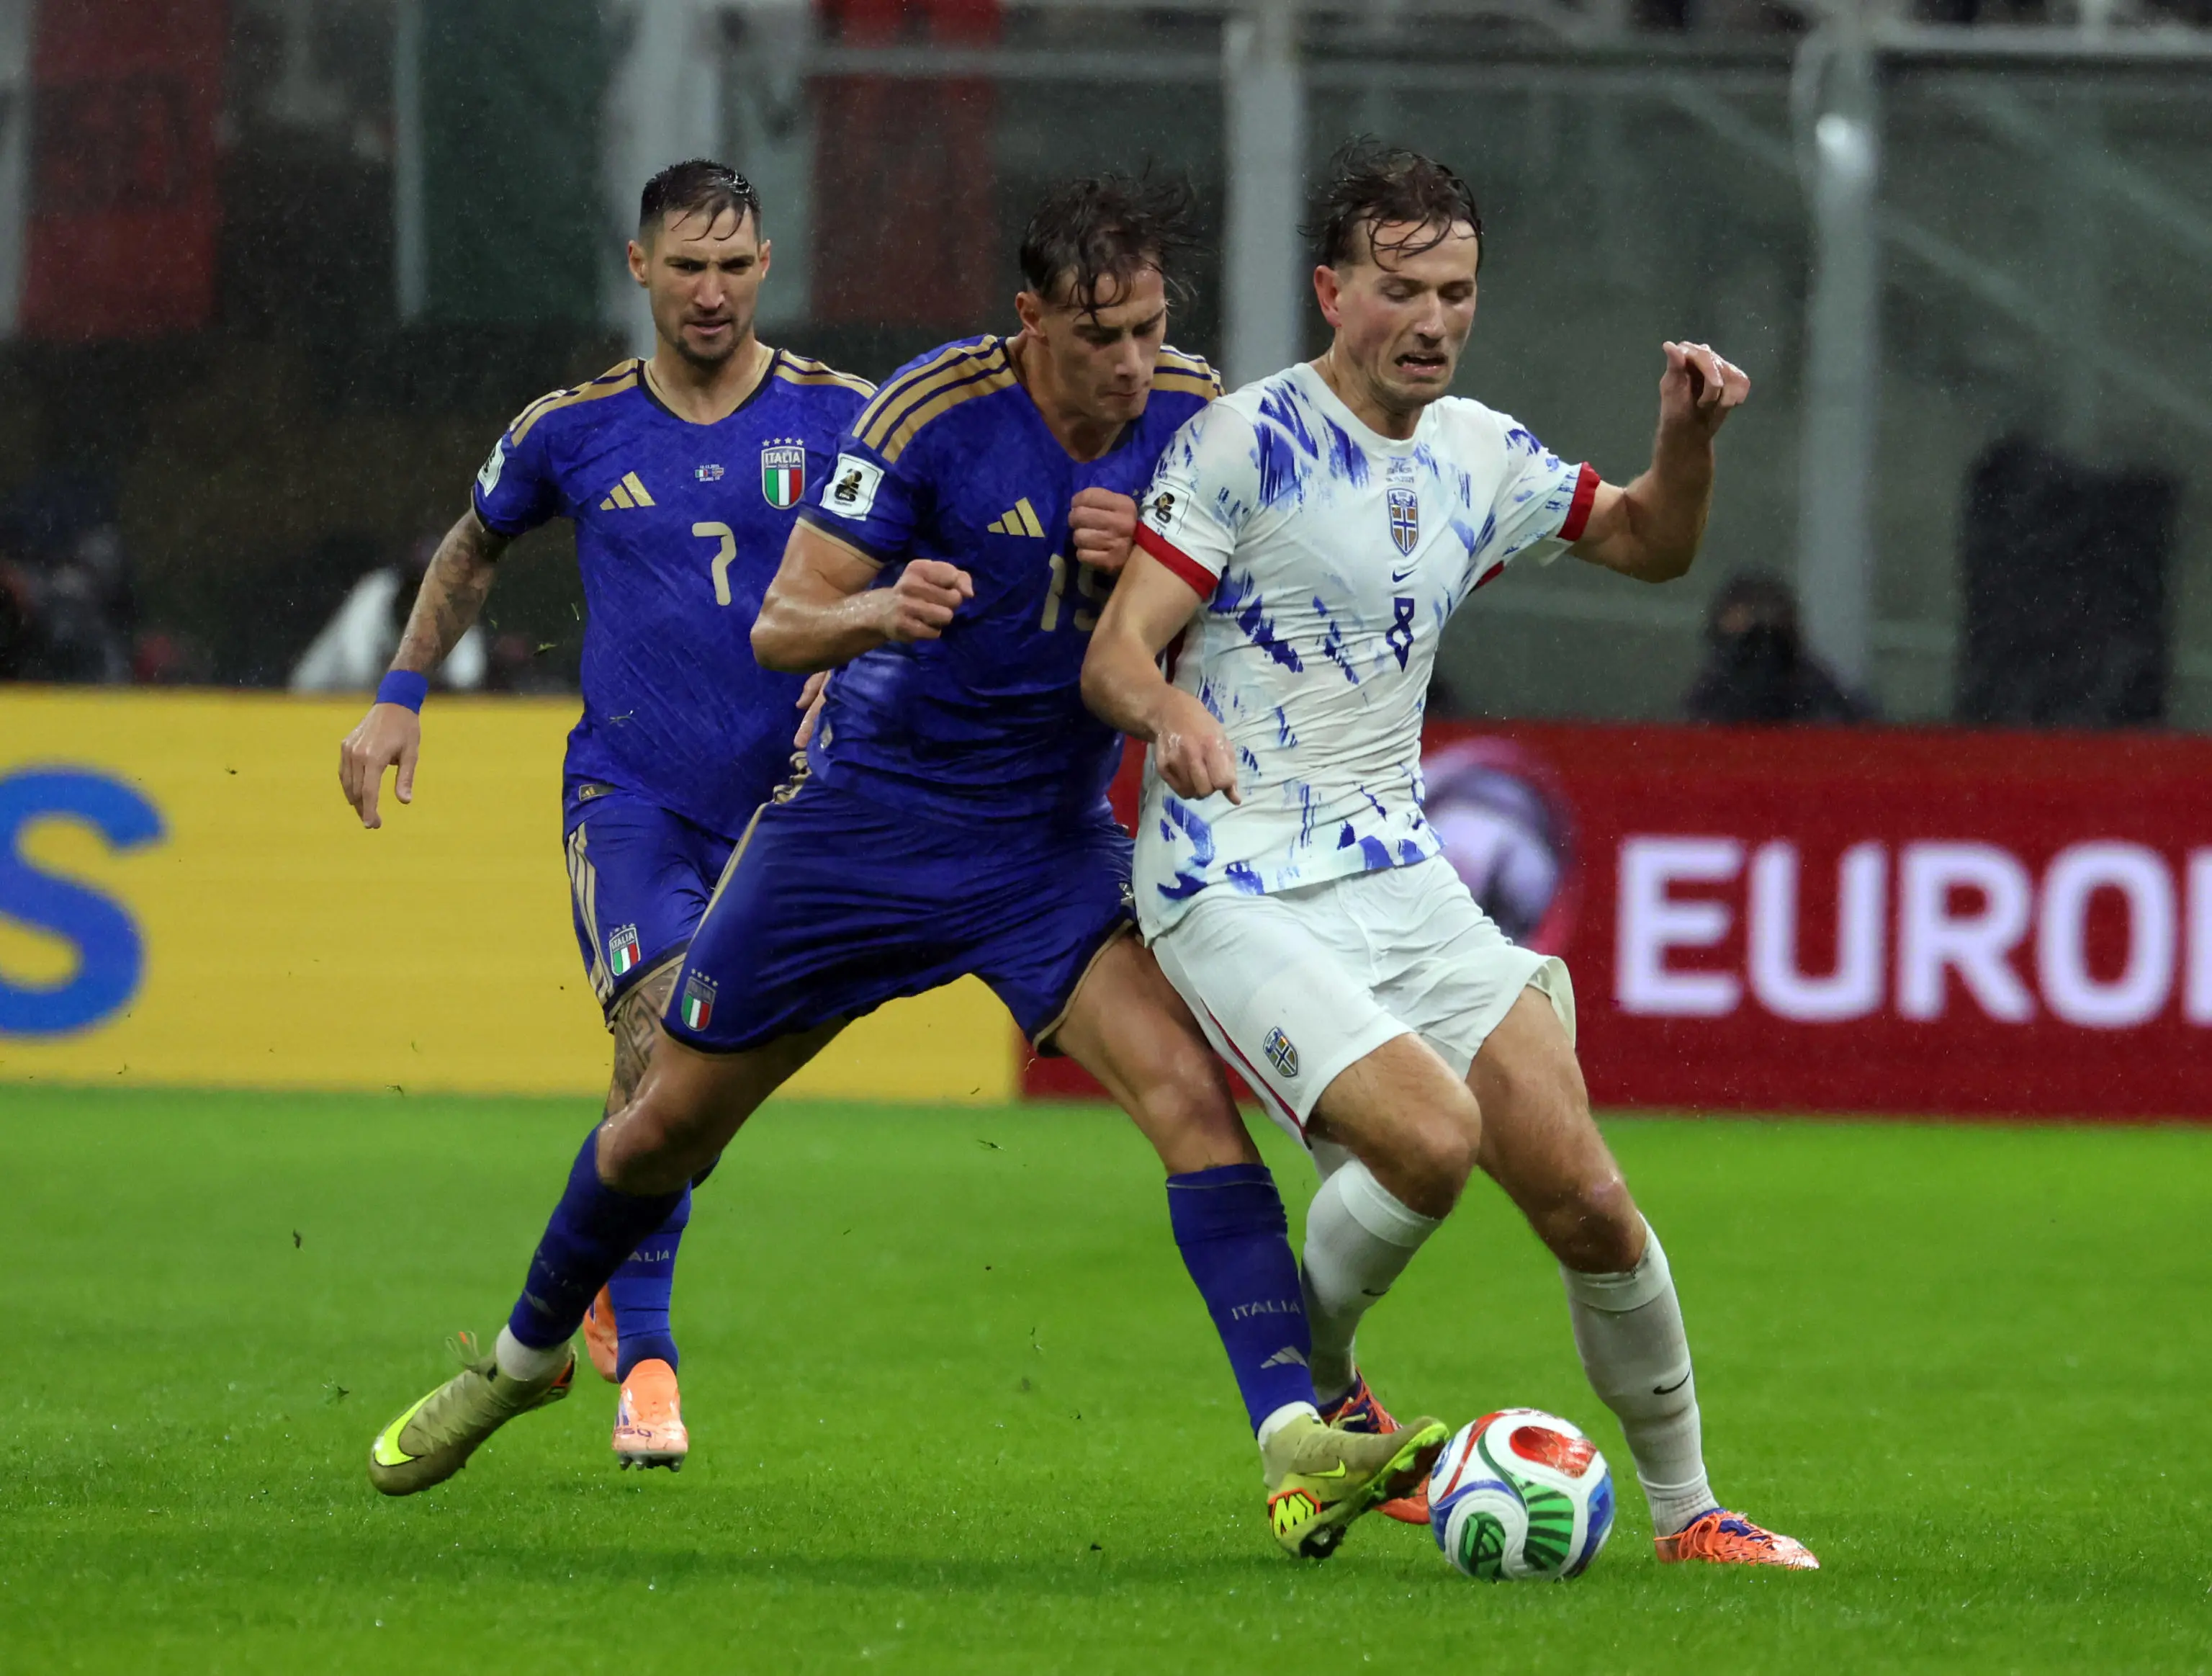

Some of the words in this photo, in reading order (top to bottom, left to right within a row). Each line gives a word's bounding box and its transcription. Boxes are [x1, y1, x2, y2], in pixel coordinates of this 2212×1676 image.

[765, 452, 801, 463] ITALIA
[692, 521, 737, 606] 7
[1385, 597, 1415, 673] 8
[611, 931, 634, 951] ITALIA
[627, 1250, 670, 1262] ALIA
[1231, 1299, 1301, 1321] ITALIA
